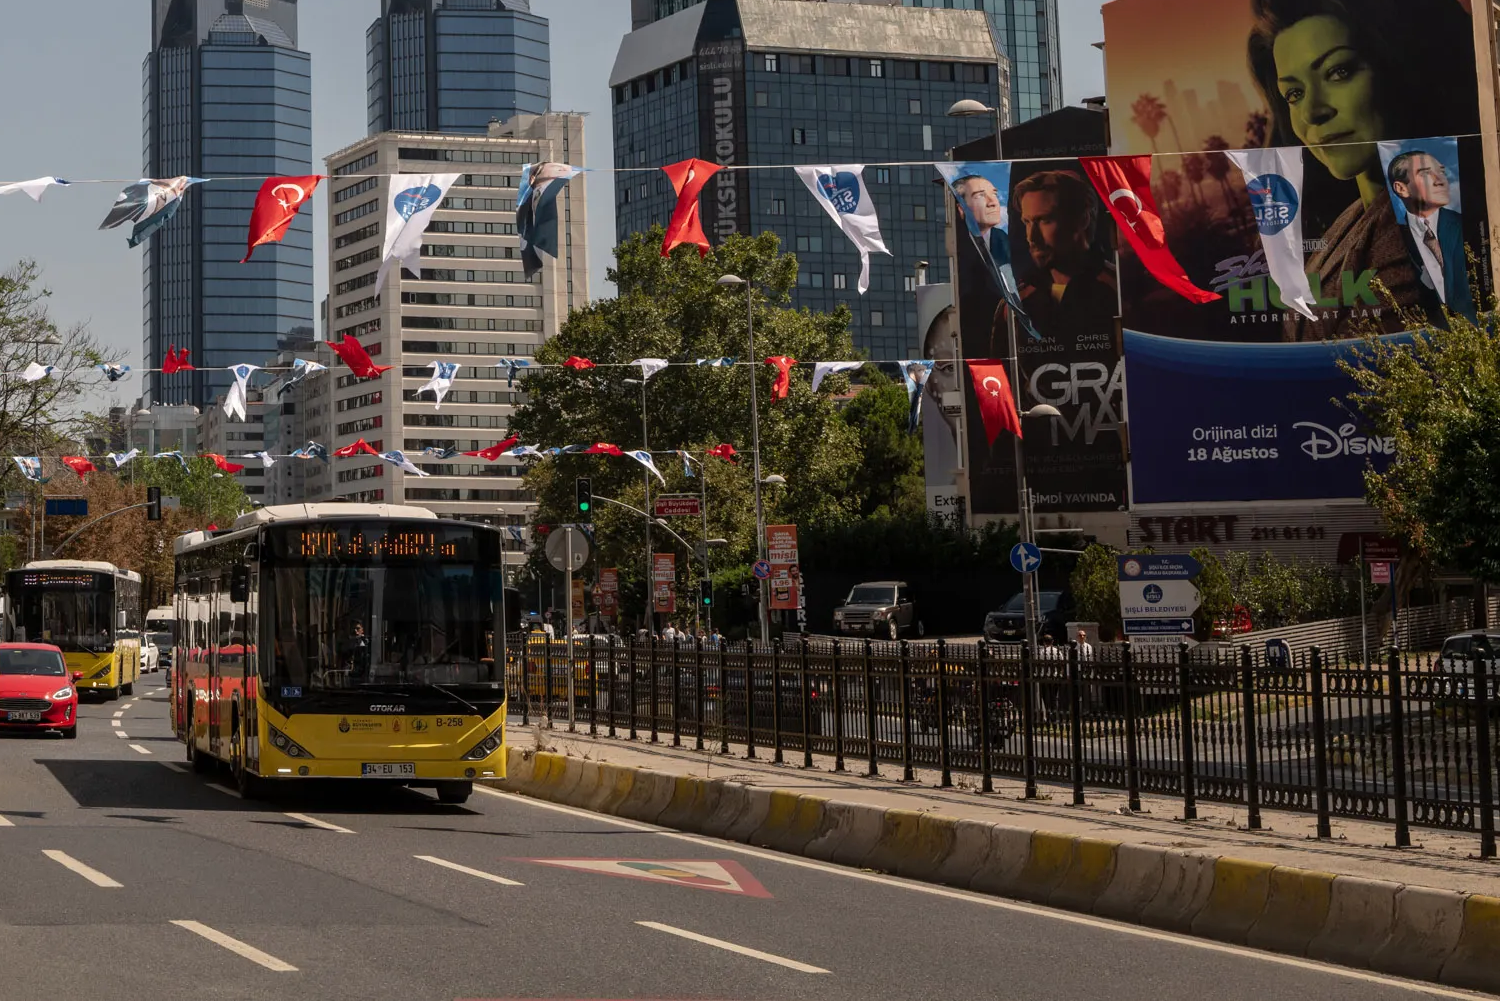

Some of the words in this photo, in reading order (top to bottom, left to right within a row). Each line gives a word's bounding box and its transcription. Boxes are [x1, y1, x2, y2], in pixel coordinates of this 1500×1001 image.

[1230, 311, 1312, 324] ATTORNE
[1322, 311, 1339, 319] AT
[1351, 308, 1382, 318] LAW
[1076, 333, 1109, 342] CHRIS
[1018, 344, 1065, 354] GOSLING
[1075, 342, 1111, 351] EVANS
[1192, 426, 1247, 442] Orijinal
[1251, 424, 1277, 438] dizi
[1188, 449, 1207, 461] 18
[1211, 447, 1278, 462] Ağustos
[1065, 492, 1116, 503] YAYINDA
[1138, 515, 1238, 543] START
[771, 550, 797, 560] misli
[369, 704, 406, 713] OTOKAR
[436, 717, 464, 727] B-258
[367, 765, 377, 774] 34
[382, 765, 393, 774] EU
[399, 764, 414, 774] 153
